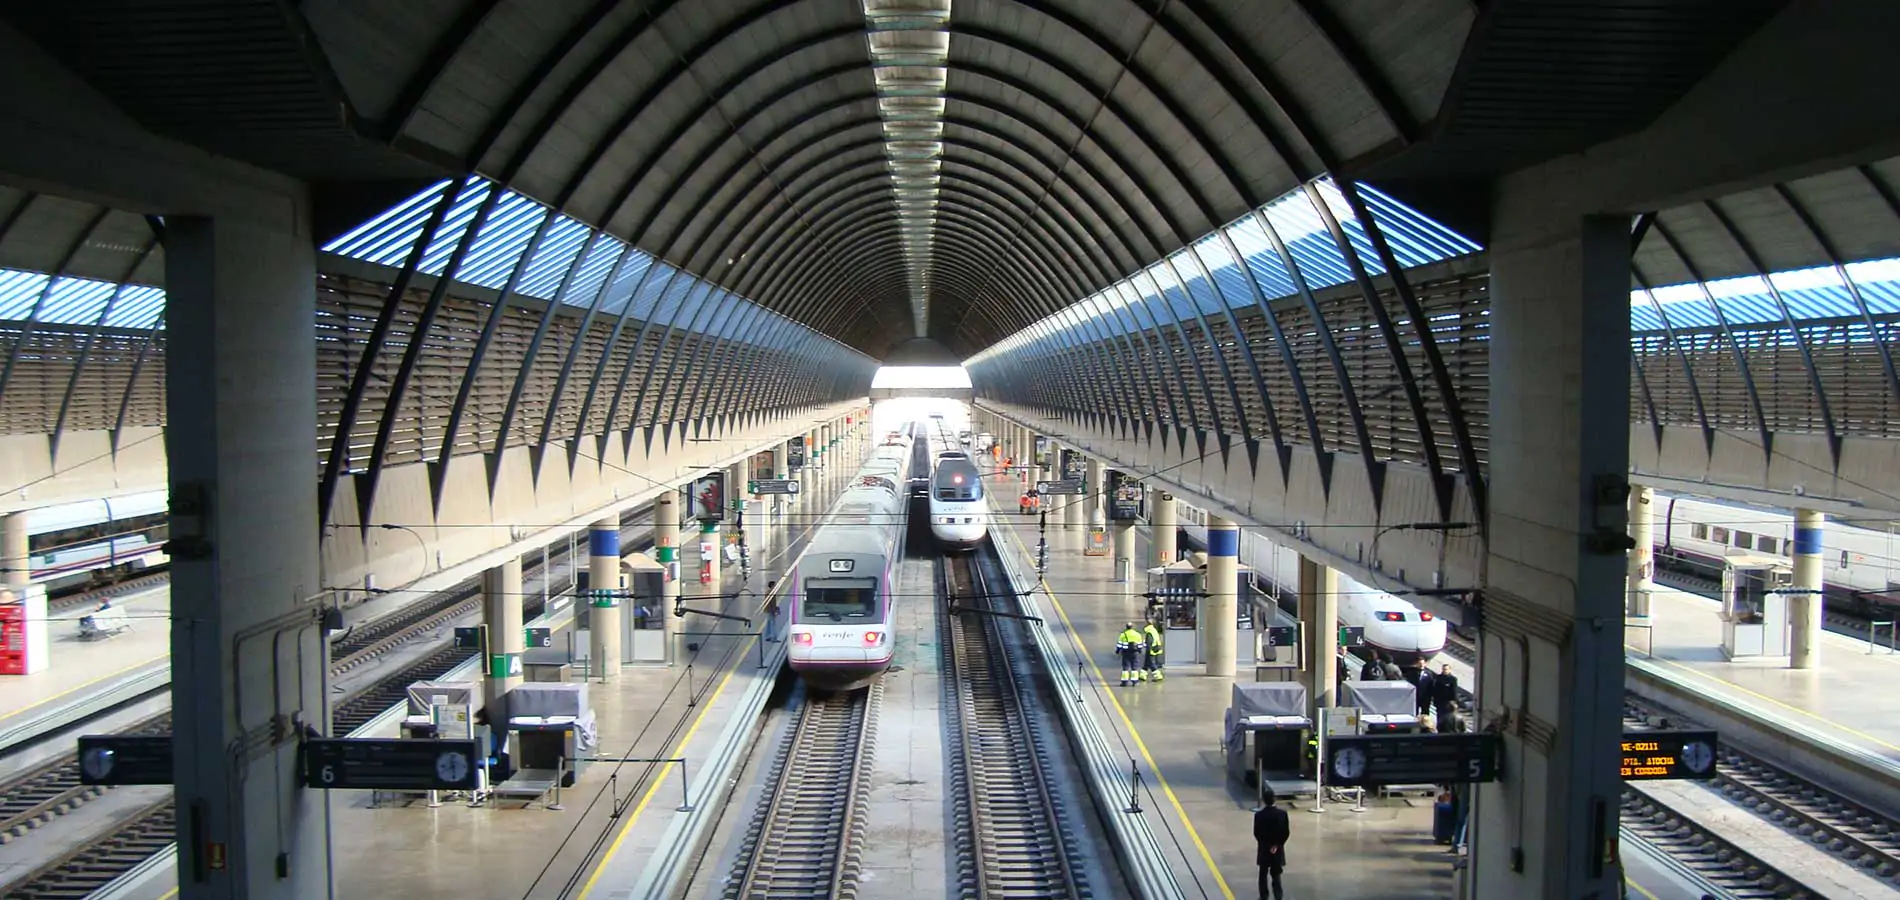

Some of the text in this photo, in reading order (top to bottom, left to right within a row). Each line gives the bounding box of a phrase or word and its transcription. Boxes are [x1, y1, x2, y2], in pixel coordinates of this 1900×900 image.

[822, 631, 856, 640] renfe
[1356, 635, 1363, 646] 4
[455, 637, 461, 646] 7
[543, 637, 551, 647] 6
[1270, 636, 1276, 646] 5
[509, 656, 523, 674] A
[1469, 758, 1481, 778] 5
[321, 765, 335, 783] 6
